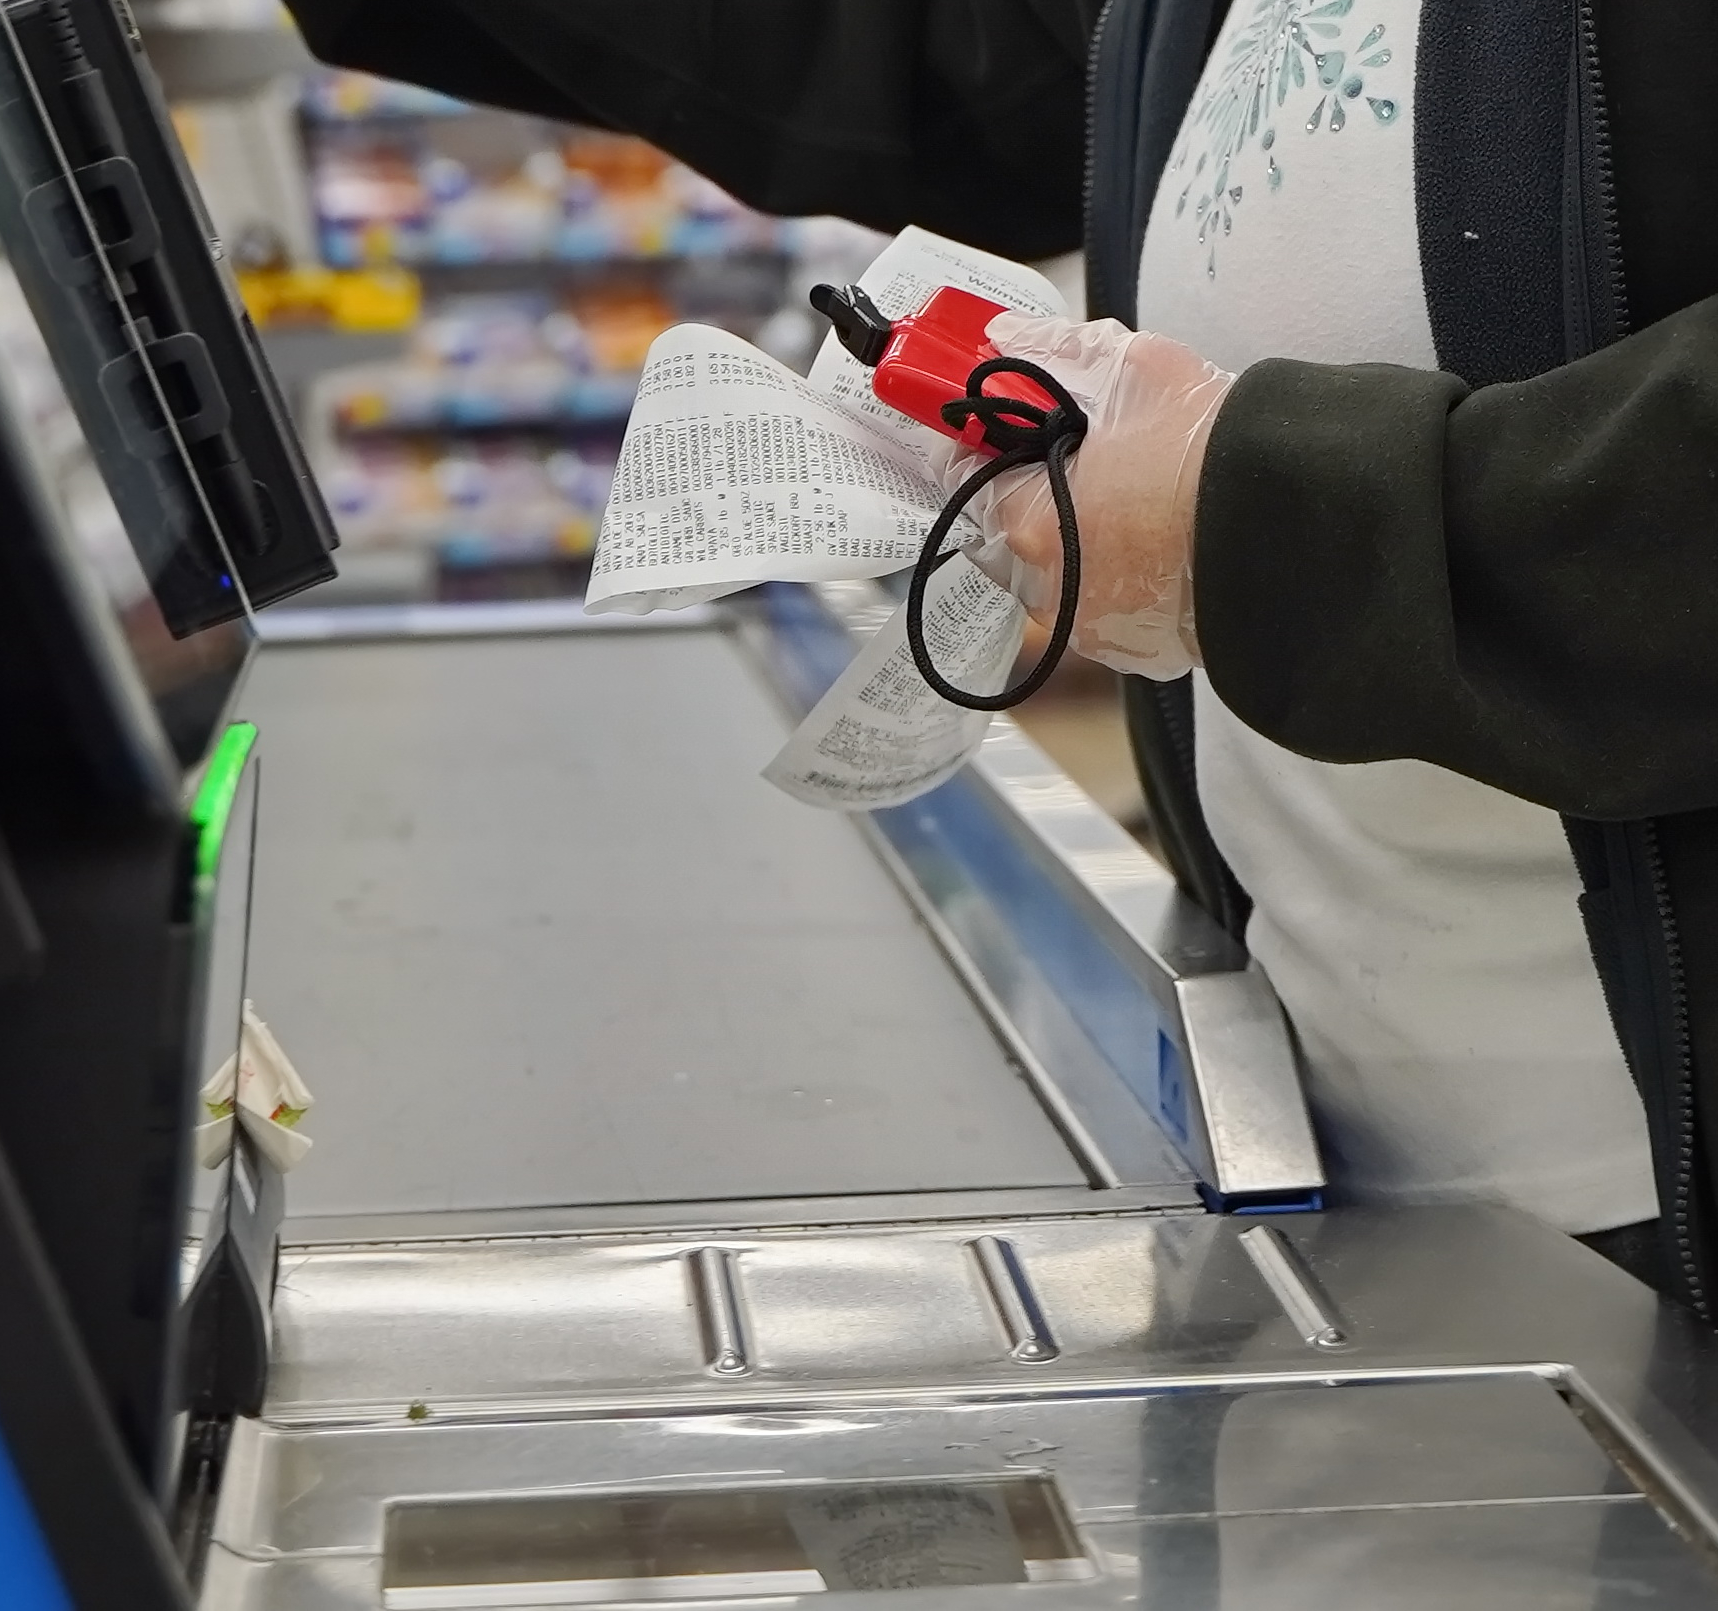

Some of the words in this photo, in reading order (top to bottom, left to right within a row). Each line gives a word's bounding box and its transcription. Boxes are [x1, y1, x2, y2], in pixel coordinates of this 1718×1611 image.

[967, 275, 1036, 313] Walmart
[710, 364, 719, 384] 3.65
[753, 501, 765, 554] ANTIBIOTIC
[838, 510, 848, 532] SOAP
[896, 518, 905, 534] BAG
[908, 519, 916, 535] BAG
[791, 515, 801, 554] HICKORY
[707, 528, 717, 560] PAPAYA
[839, 538, 848, 556] BAR
[850, 538, 860, 557] BAG
[861, 539, 871, 557] BAG
[872, 540, 883, 558] BAG
[884, 539, 894, 557] BAG
[895, 541, 903, 558] PET
[905, 542, 915, 558] PET
